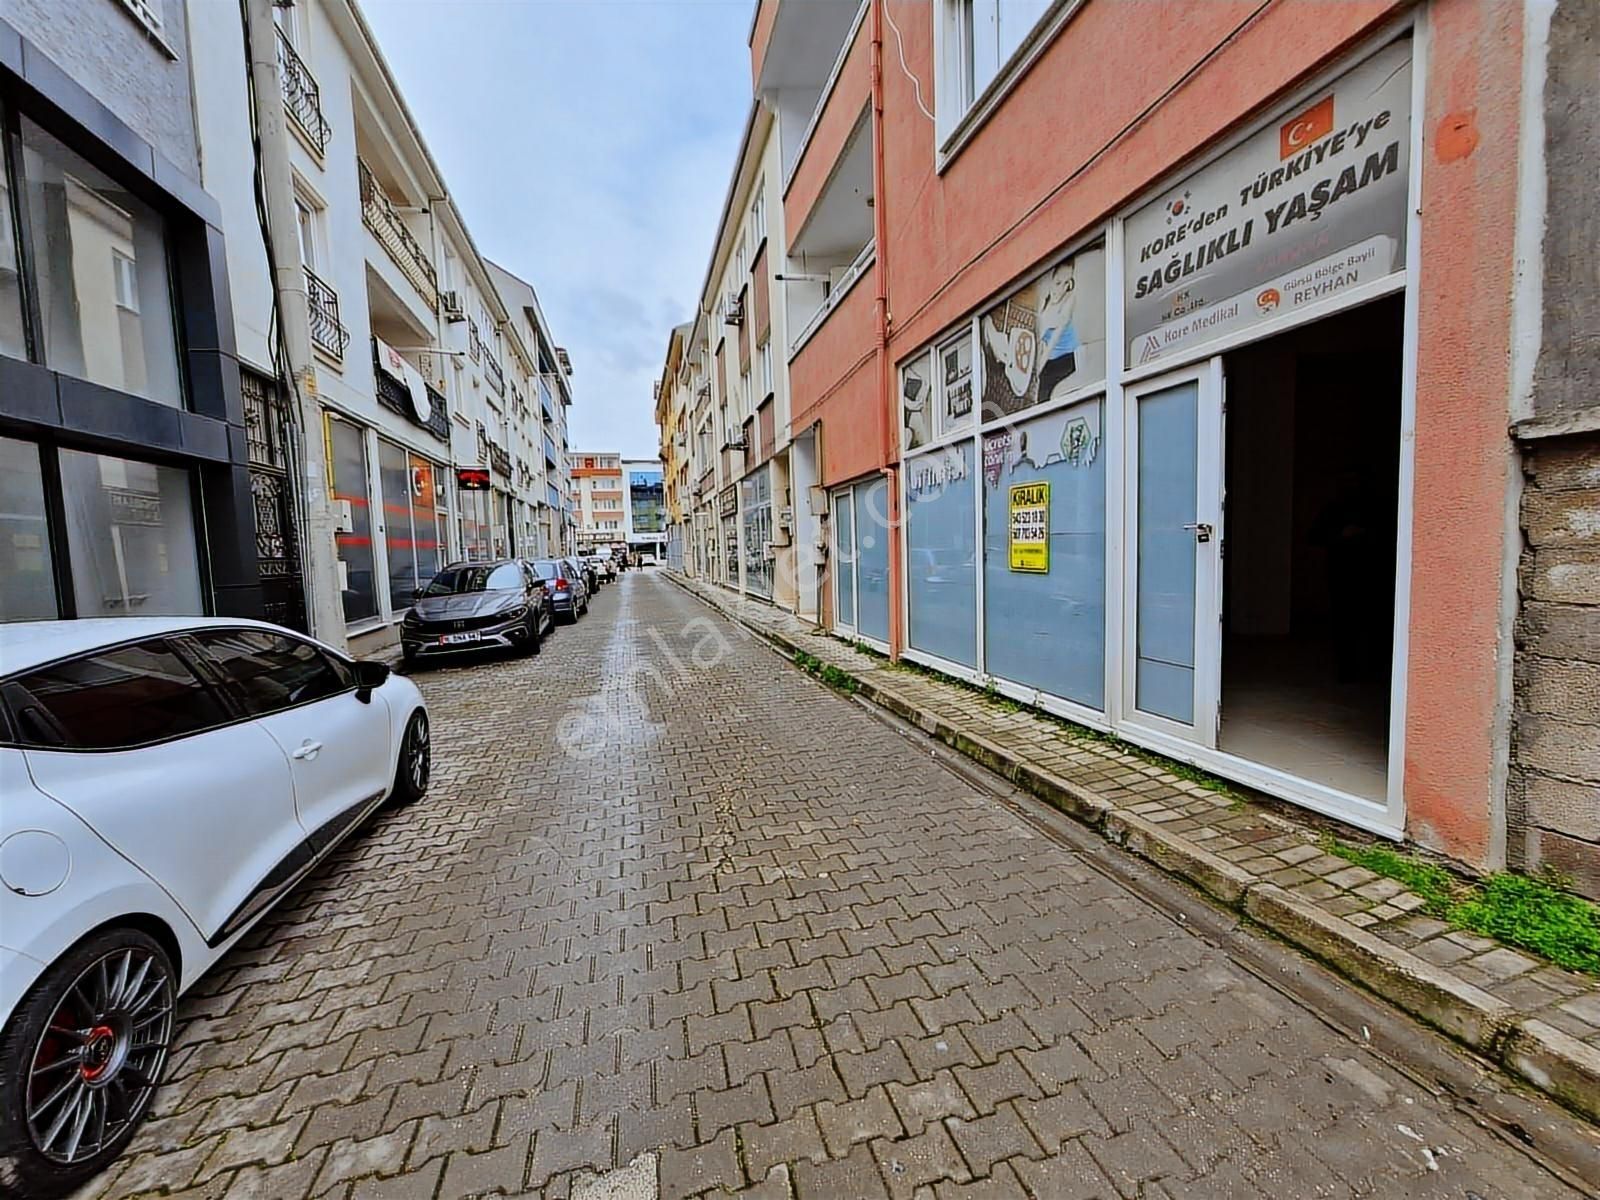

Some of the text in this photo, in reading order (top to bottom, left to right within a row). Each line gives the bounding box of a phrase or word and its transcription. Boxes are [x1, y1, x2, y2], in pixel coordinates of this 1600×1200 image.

[1135, 219, 1254, 299] SAĞLIKLI
[1264, 140, 1400, 236] YAŞAM
[1140, 204, 1228, 262] KORE'den
[1240, 110, 1391, 207] TÜRKİYE'ye
[1191, 303, 1239, 335] Medikal
[1294, 269, 1359, 305] REYHAN
